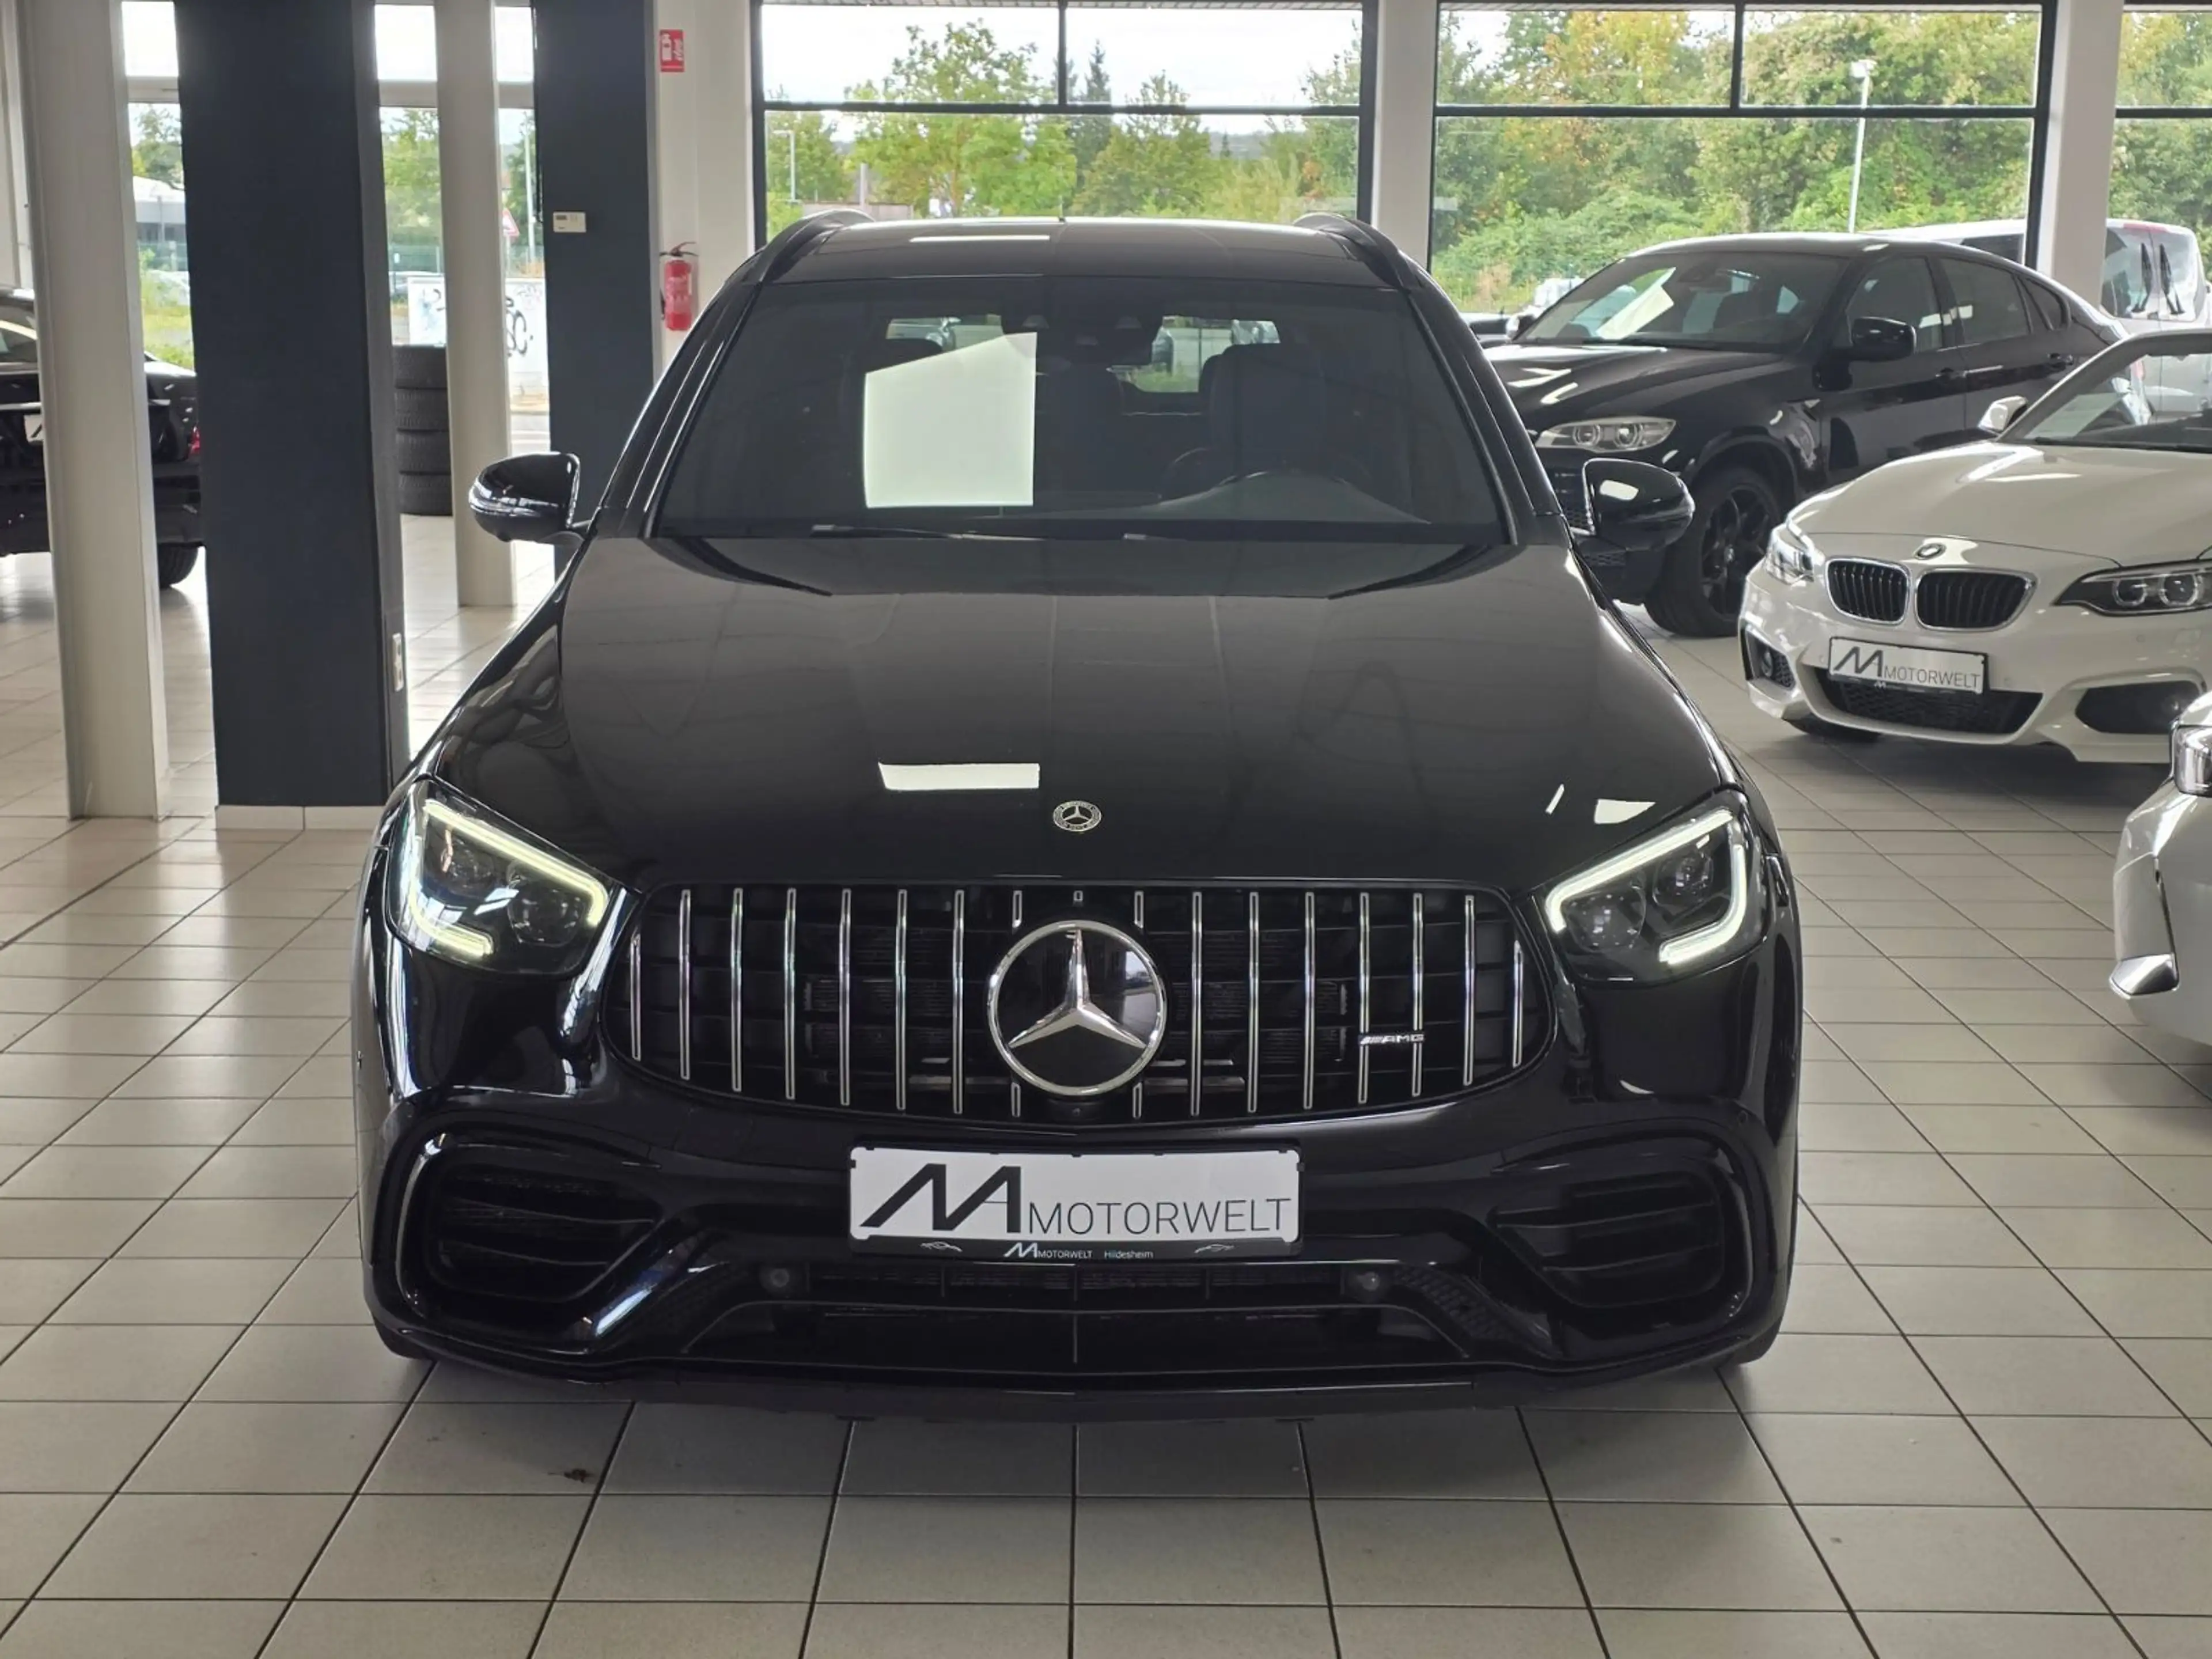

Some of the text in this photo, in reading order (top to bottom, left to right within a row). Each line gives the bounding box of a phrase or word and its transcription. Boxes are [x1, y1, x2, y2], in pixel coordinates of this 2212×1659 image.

[1884, 664, 1981, 688] MOTORWELT
[1382, 1034, 1425, 1044] AMG
[1029, 1198, 1292, 1235] MOTORWELT
[1038, 1250, 1093, 1259] MOTORWELT
[1104, 1249, 1154, 1259] Hildesheim
